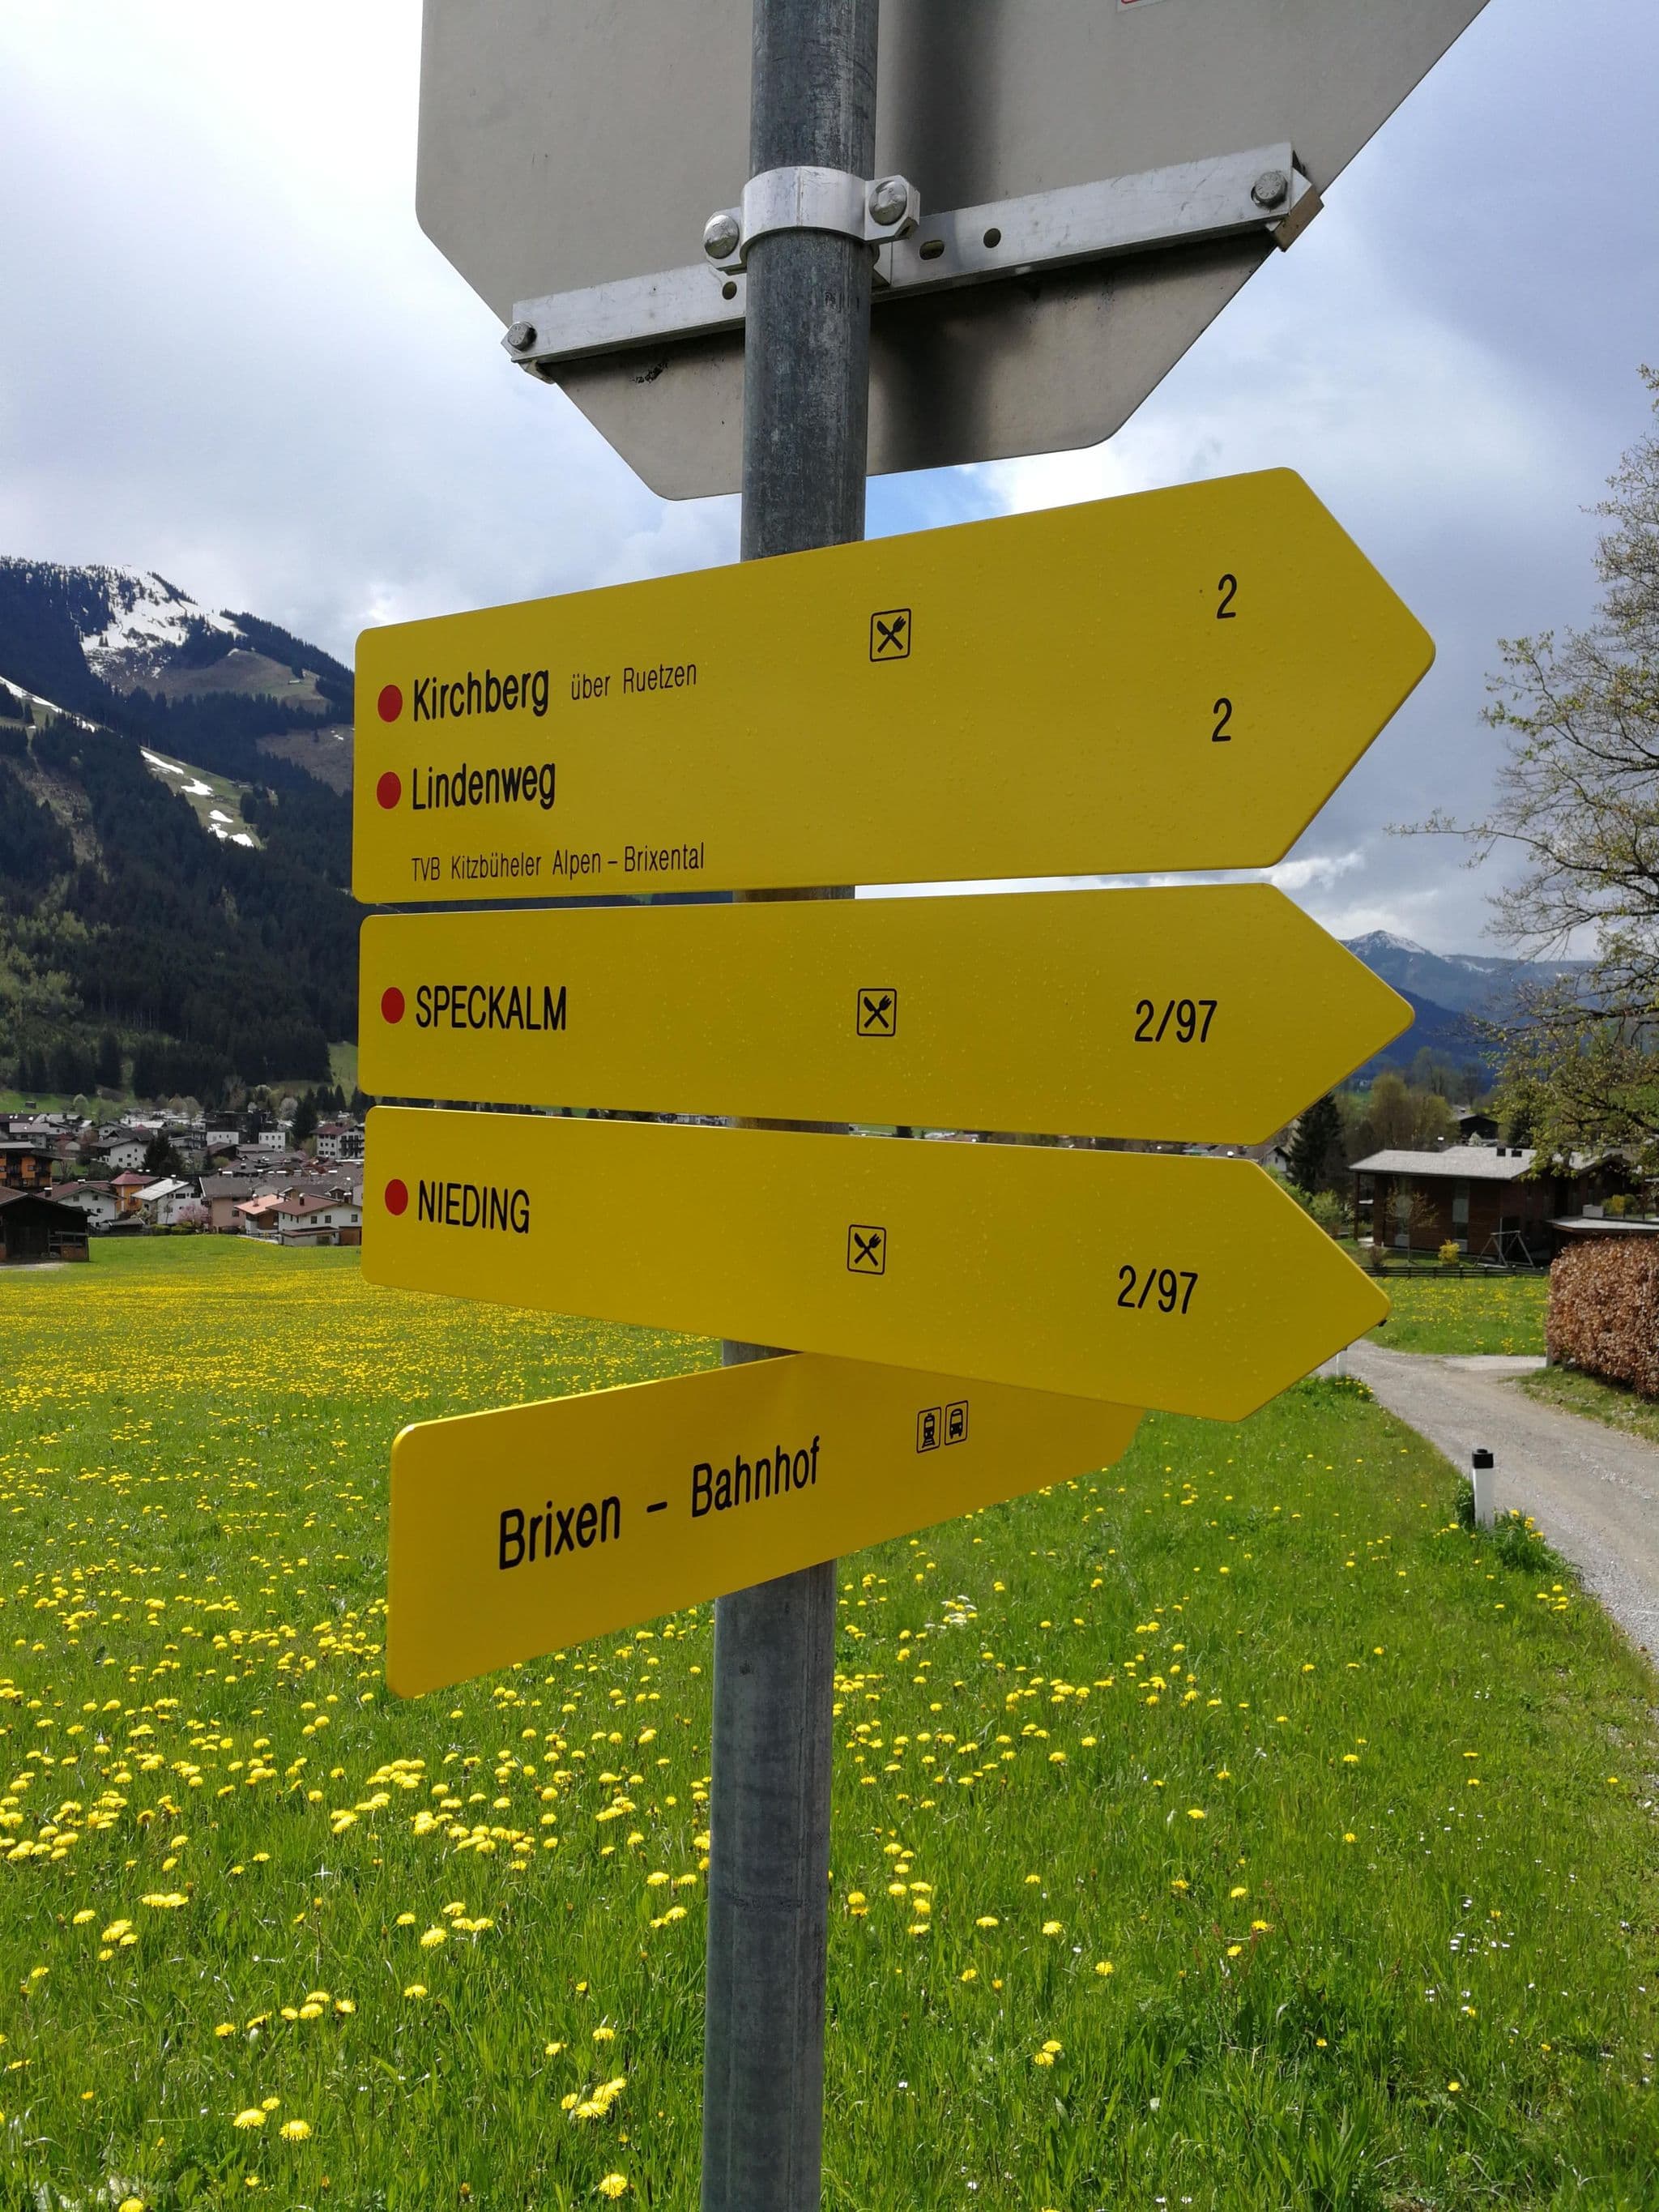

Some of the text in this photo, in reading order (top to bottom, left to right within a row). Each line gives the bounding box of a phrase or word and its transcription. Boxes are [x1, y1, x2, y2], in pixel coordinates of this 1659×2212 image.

[1217, 573, 1238, 620] 2
[413, 664, 697, 722] Kirchberg über Ruetzen
[1211, 697, 1233, 743] 2
[412, 762, 556, 810] Lindenweg
[411, 856, 441, 882] TVB
[451, 852, 542, 880] Kitzbüheler
[552, 848, 601, 880] Alpen
[625, 842, 704, 873] Brixental
[416, 984, 567, 1031] SPECKALM
[1134, 998, 1218, 1044] 2/97
[418, 1179, 530, 1234] NIEDING
[1117, 1264, 1199, 1315] 2/97
[498, 1496, 621, 1570] Brixen
[691, 1435, 821, 1518] Bahnhof
